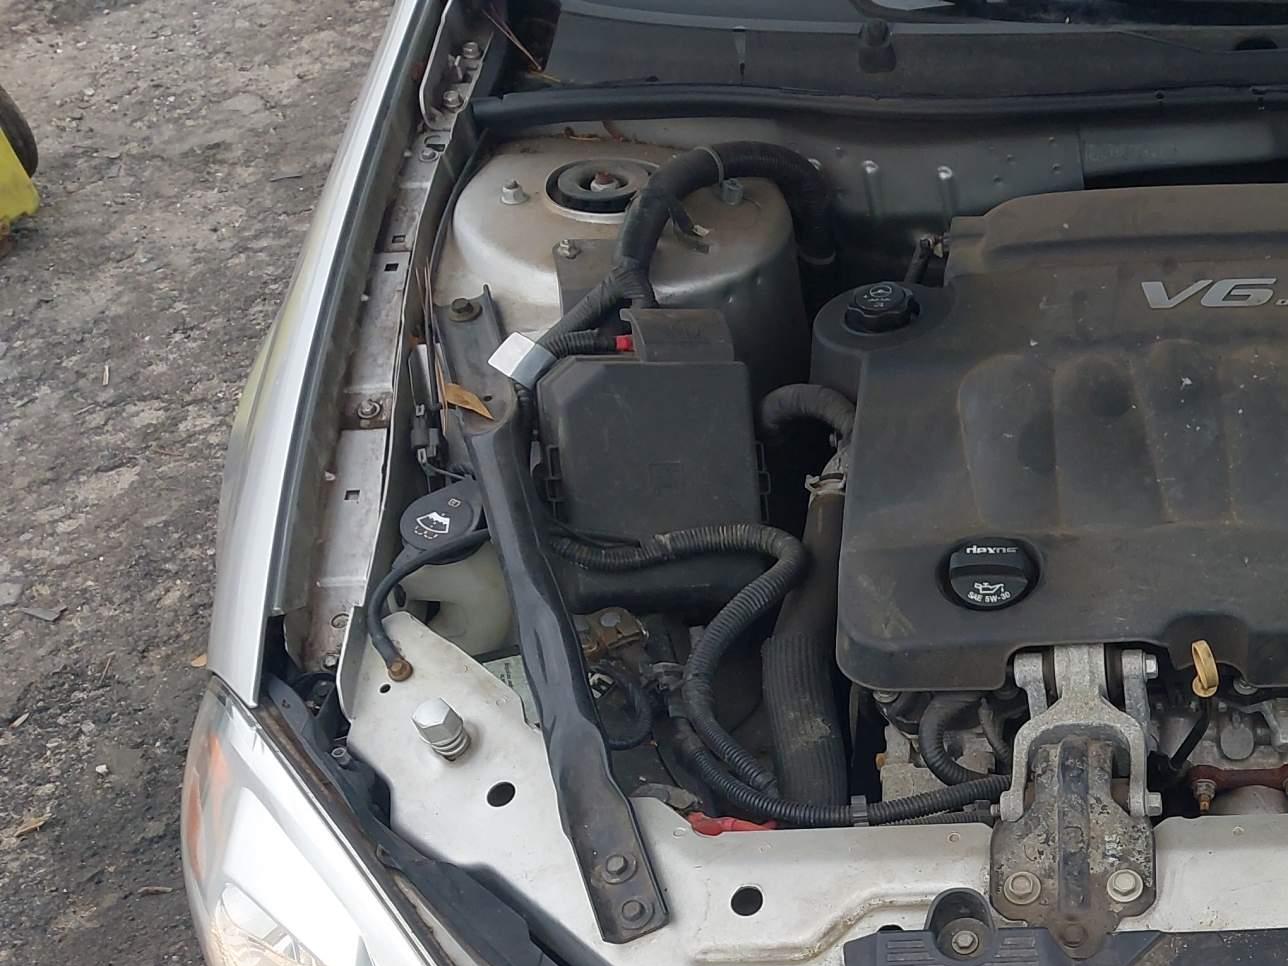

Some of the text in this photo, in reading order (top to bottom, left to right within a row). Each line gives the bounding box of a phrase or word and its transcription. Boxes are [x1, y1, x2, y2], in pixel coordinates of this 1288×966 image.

[1141, 278, 1277, 309] V6
[968, 592, 1010, 602] SAE 5W-30
